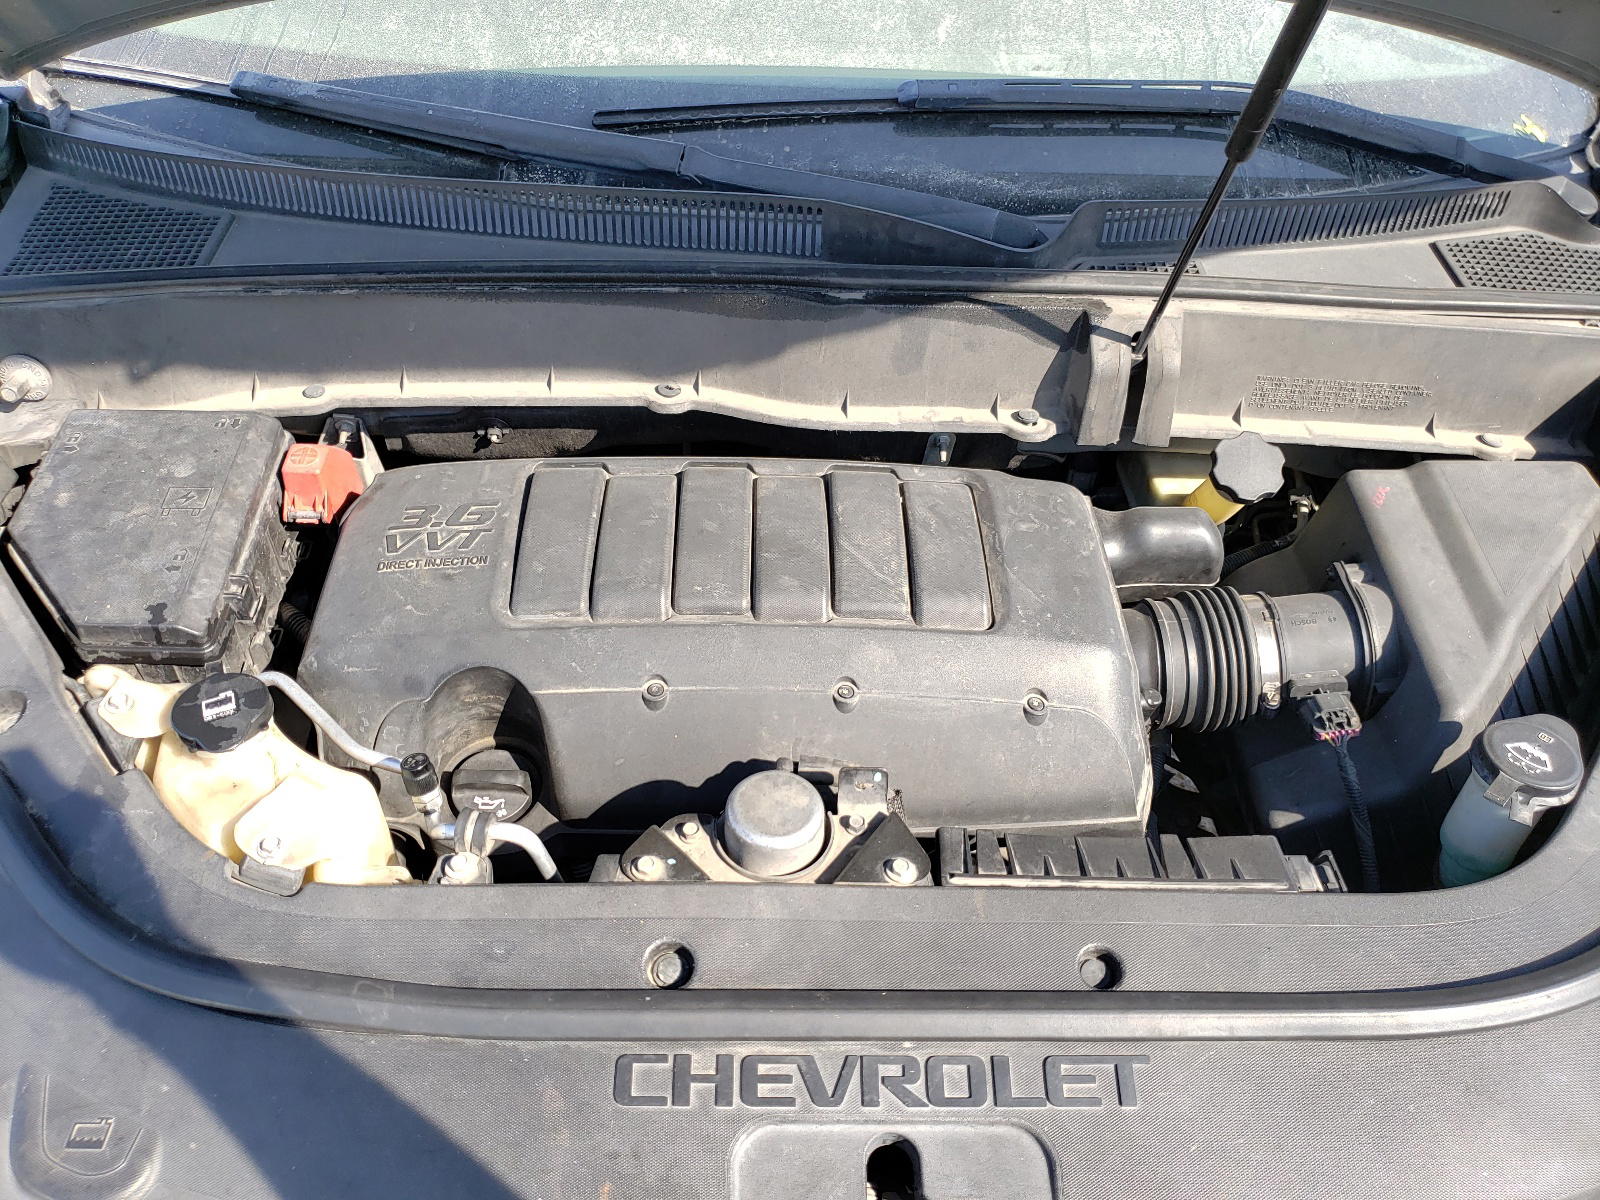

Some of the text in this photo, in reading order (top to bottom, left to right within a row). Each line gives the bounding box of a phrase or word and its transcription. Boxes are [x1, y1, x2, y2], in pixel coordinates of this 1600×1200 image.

[387, 503, 501, 532] 3.6
[385, 529, 494, 555] VVT
[376, 555, 489, 573] DIRECT INJECTION
[613, 1054, 1151, 1108] CHEVROLET
